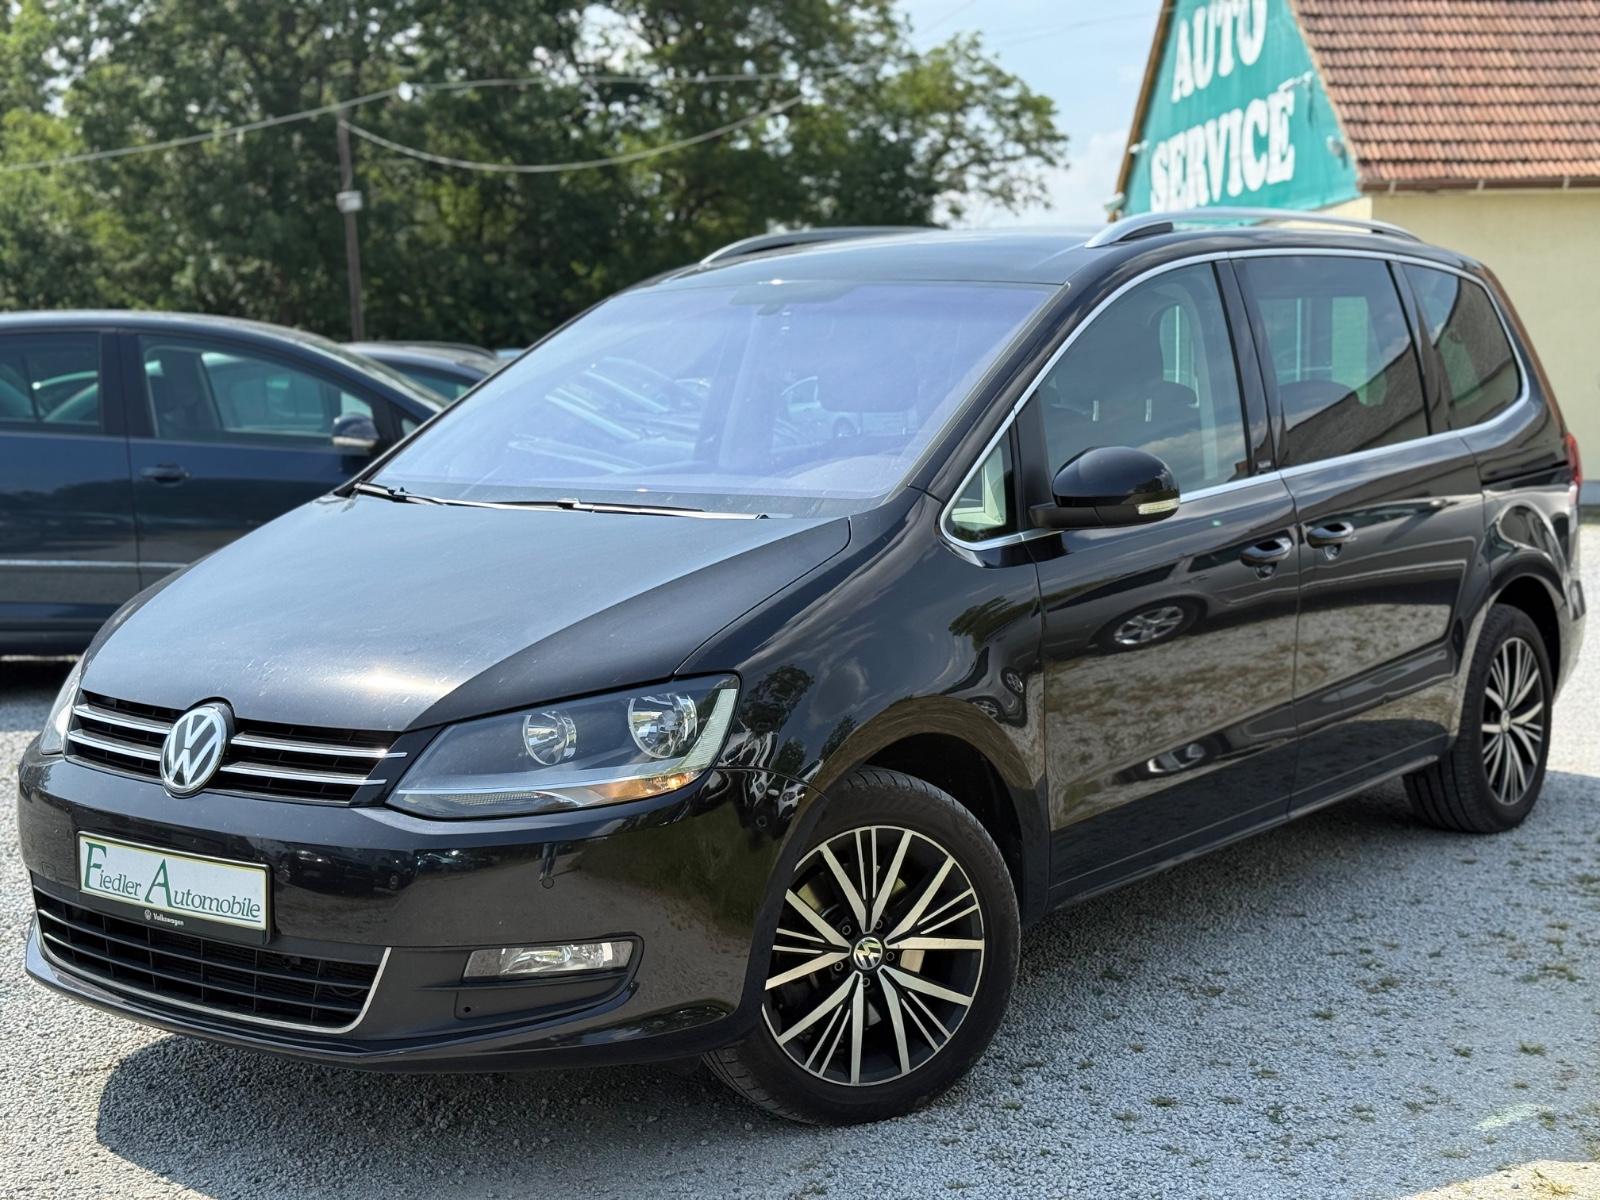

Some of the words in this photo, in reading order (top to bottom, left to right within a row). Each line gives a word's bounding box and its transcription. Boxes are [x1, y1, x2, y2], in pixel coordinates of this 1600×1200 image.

[1171, 0, 1268, 103] AUTO
[1150, 89, 1296, 213] SERVICE
[84, 842, 142, 897] Fiedler
[144, 858, 261, 919] Automobile
[153, 912, 185, 926] Volkswagen
